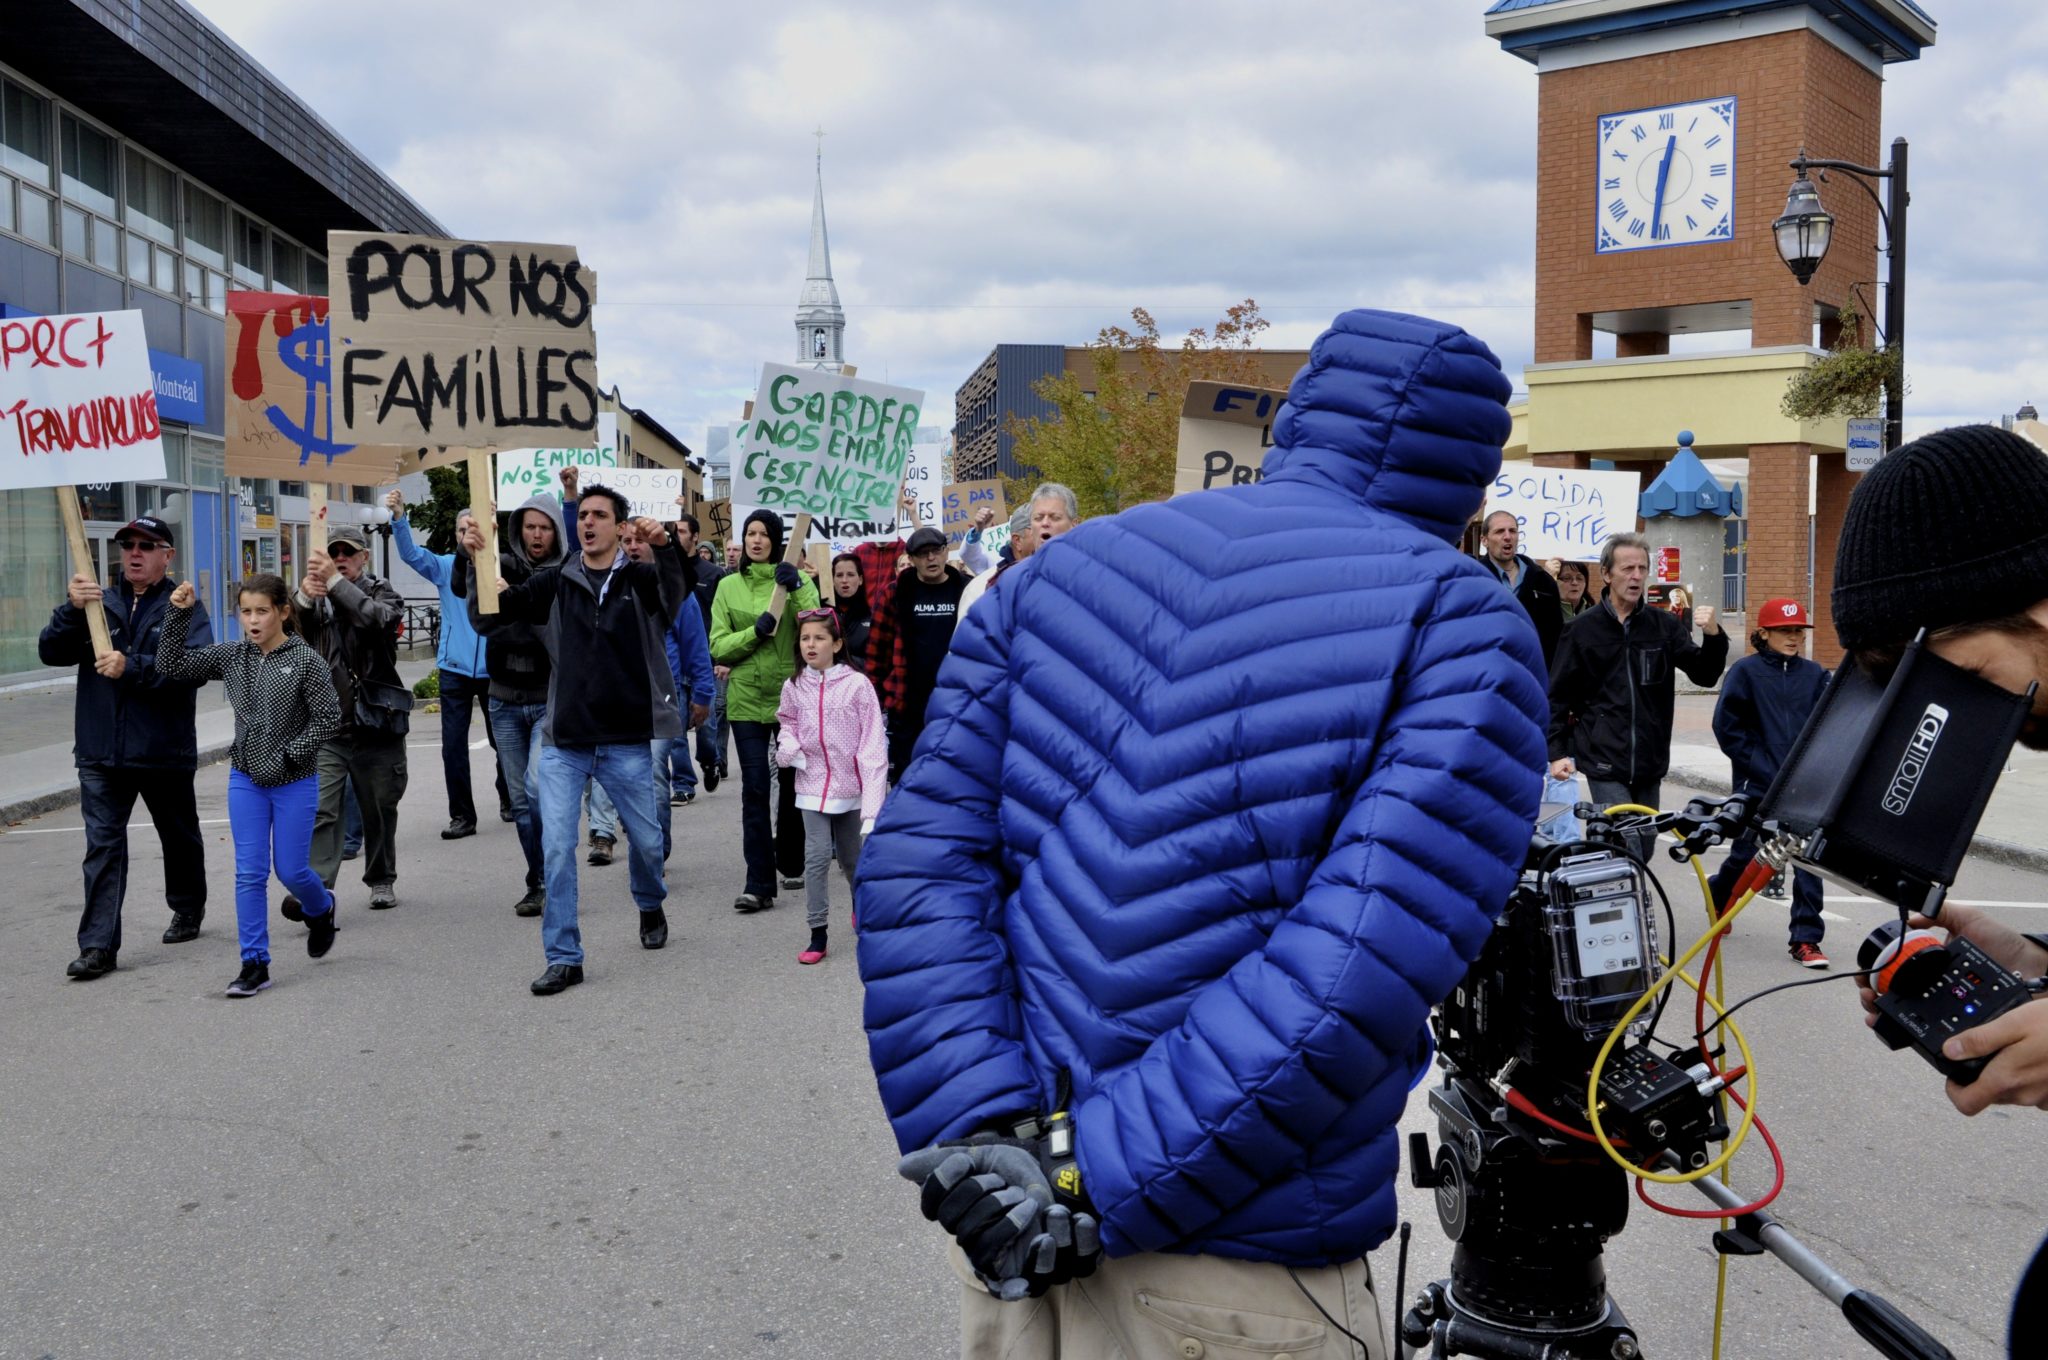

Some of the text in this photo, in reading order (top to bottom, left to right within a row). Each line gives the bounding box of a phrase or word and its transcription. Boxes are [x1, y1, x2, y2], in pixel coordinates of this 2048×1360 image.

[346, 239, 590, 328] POUR NOS
[152, 370, 198, 403] Montréal
[755, 418, 820, 452] NOS
[533, 447, 616, 468] EMPLOIS
[502, 465, 551, 487] NOS
[614, 473, 641, 488] SO
[651, 474, 678, 489] SO
[814, 463, 896, 507] NOTRE
[969, 488, 994, 505] PAS
[914, 603, 956, 612] ALMA 2015
